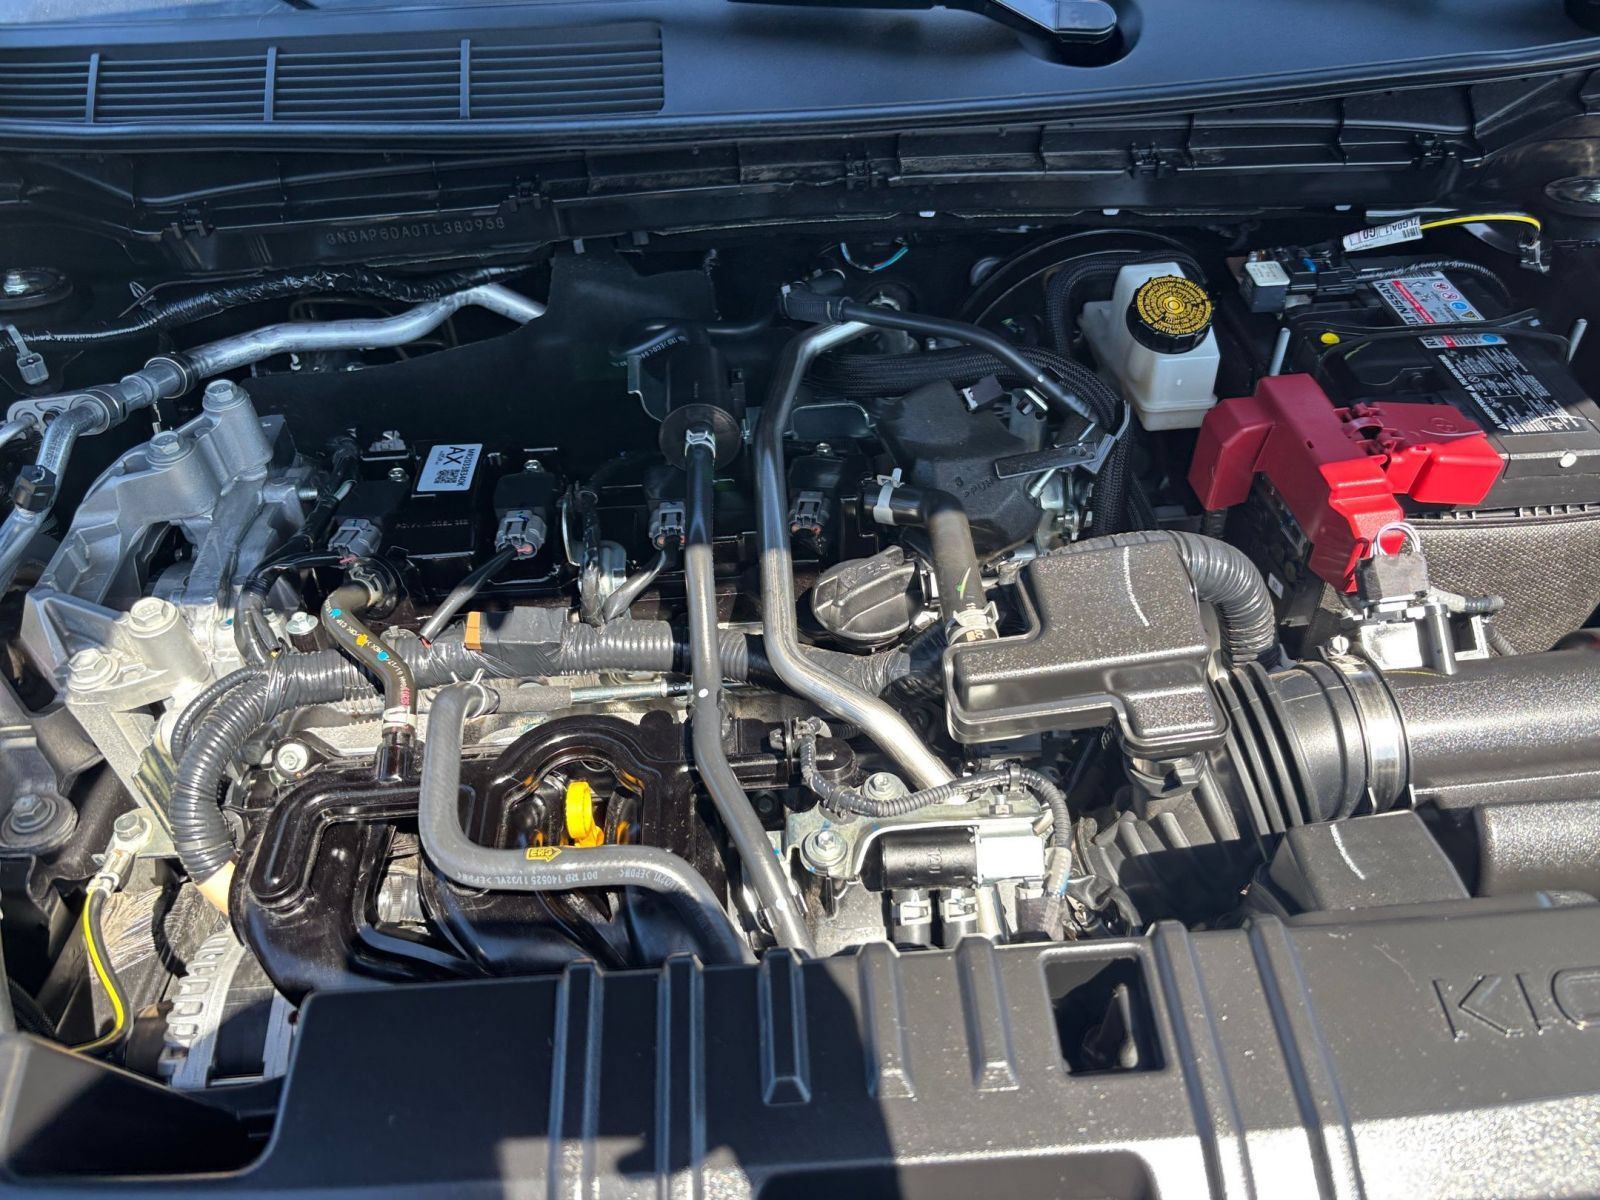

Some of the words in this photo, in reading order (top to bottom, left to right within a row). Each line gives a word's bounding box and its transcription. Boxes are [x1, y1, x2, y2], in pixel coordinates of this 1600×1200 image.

[1375, 282, 1410, 314] NISSAN
[443, 446, 466, 465] AX
[531, 874, 562, 885] 140525
[581, 870, 598, 881] DOT
